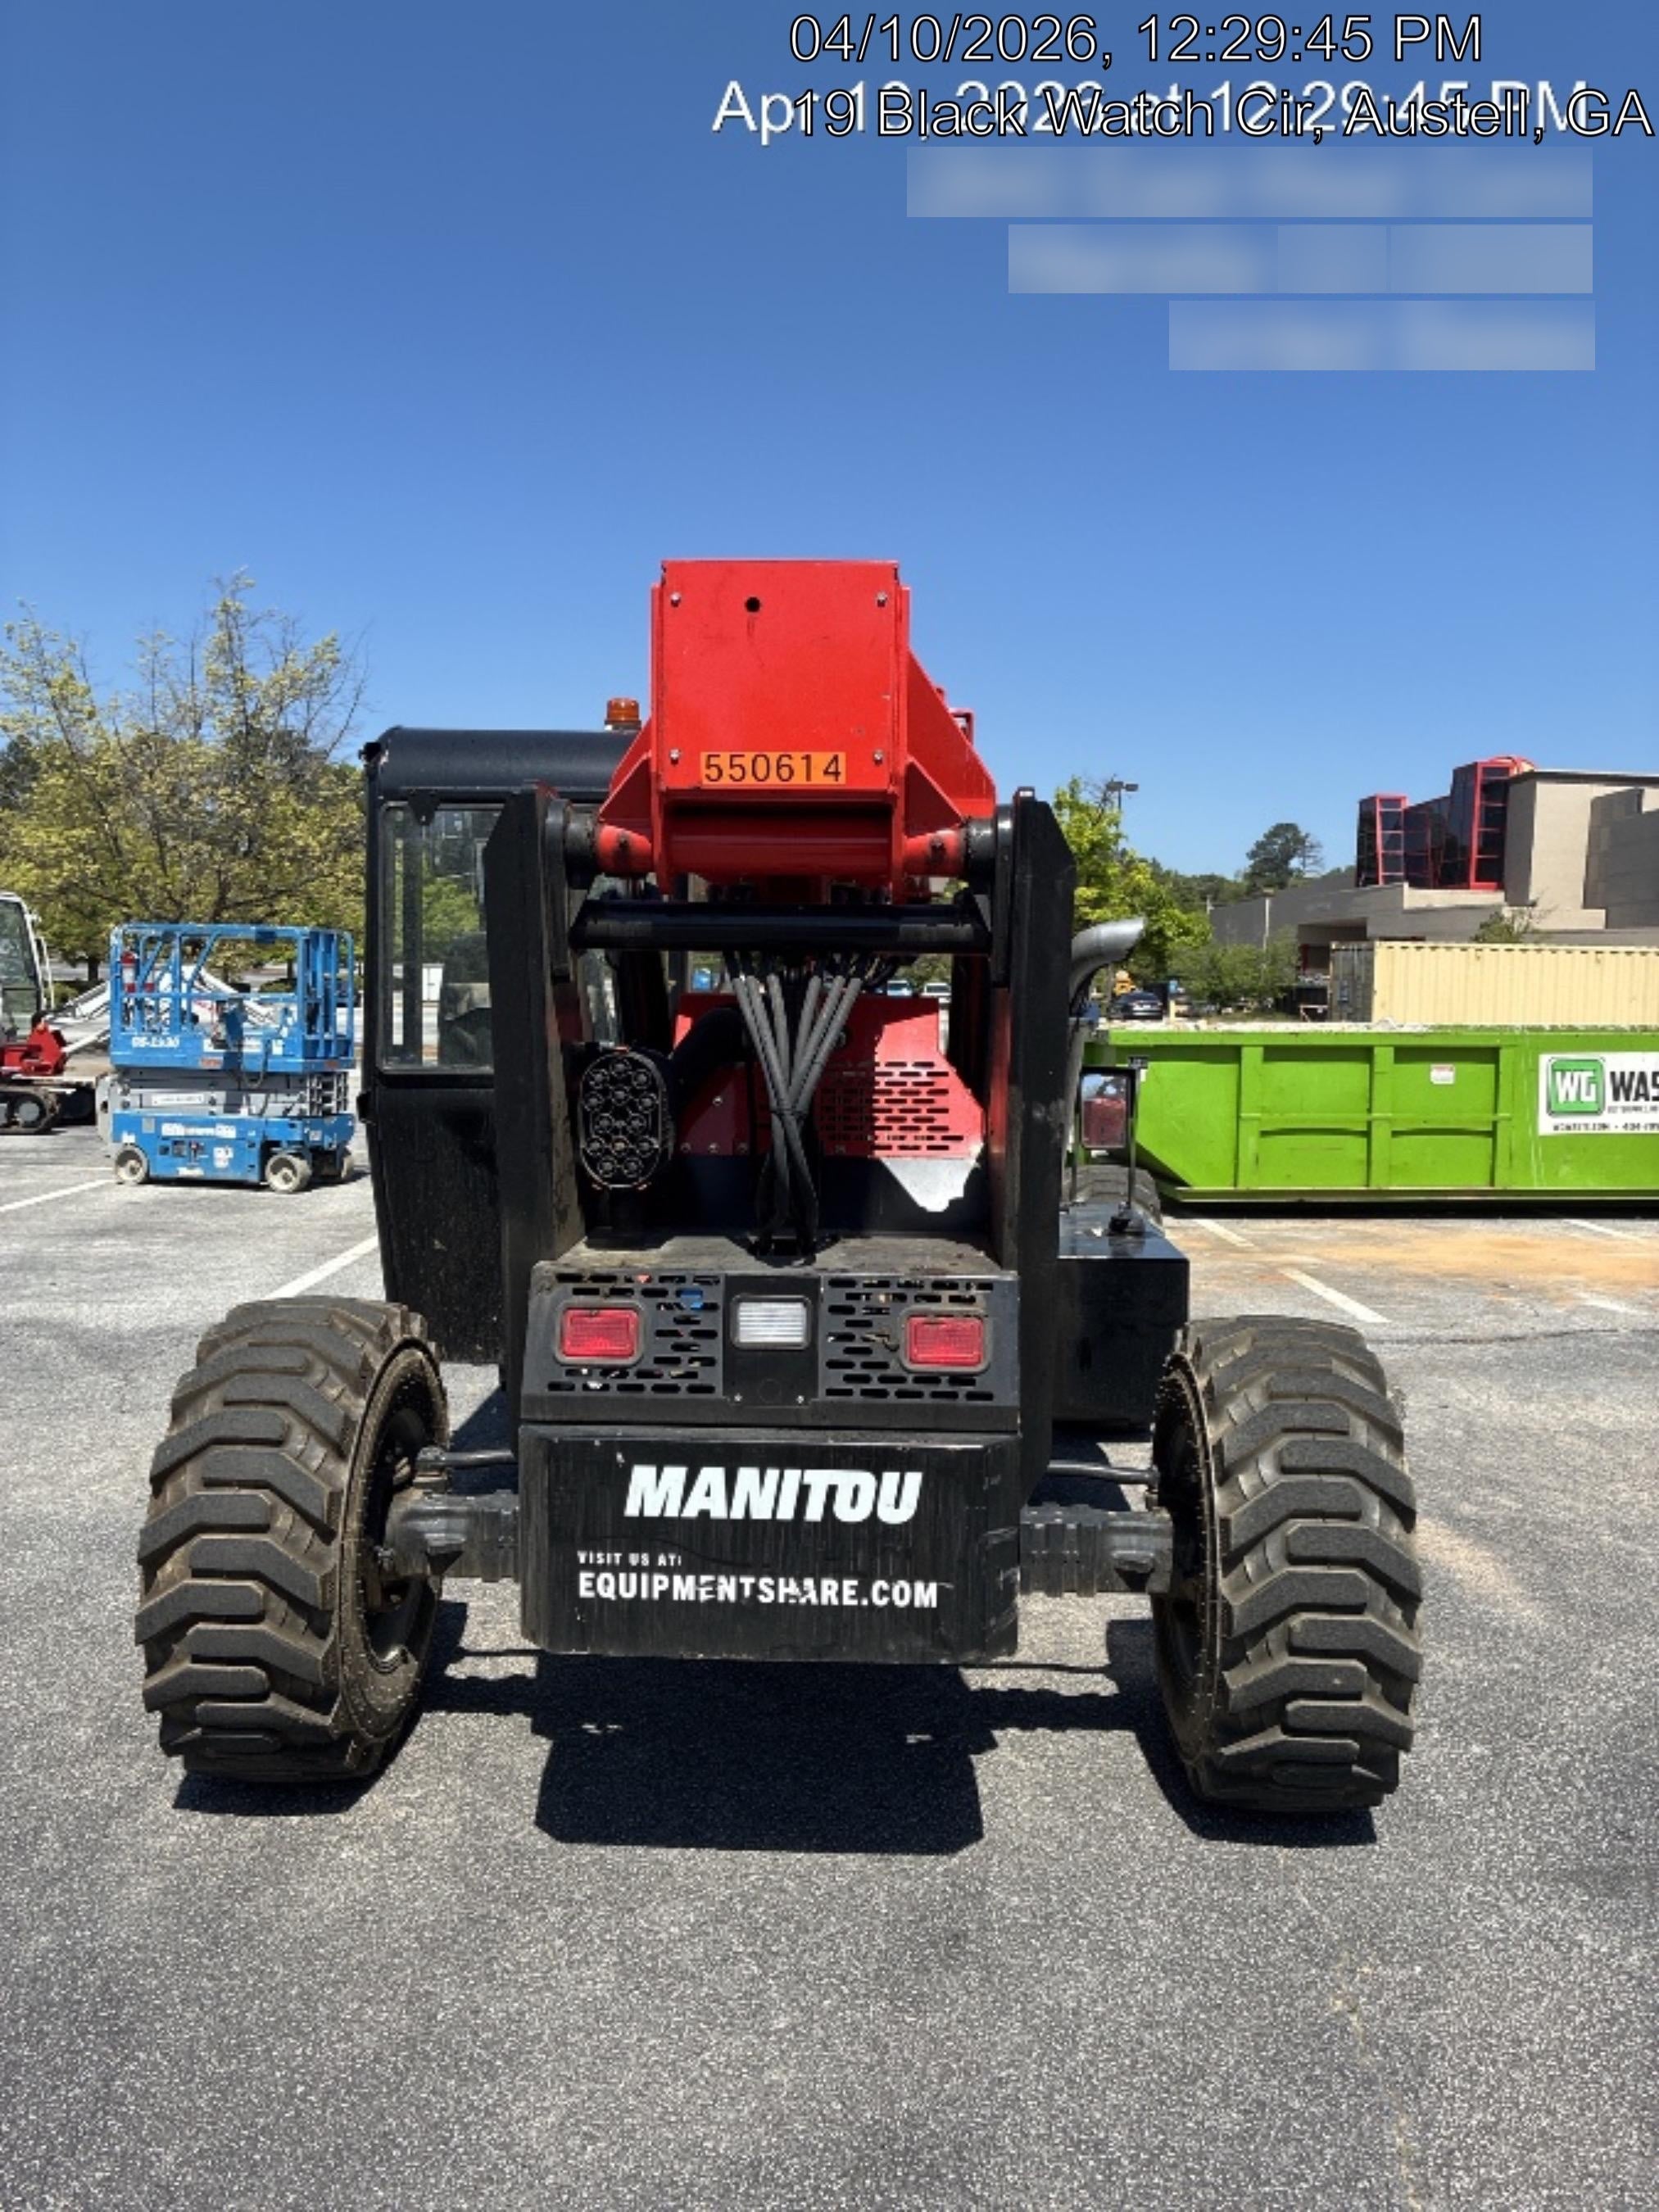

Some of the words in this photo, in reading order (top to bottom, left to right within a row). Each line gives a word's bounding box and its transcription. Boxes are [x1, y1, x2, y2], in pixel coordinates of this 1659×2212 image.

[704, 754, 842, 782] 550614
[1555, 1070, 1598, 1104] WG
[623, 1464, 923, 1525] MANITOU
[577, 1550, 623, 1566] VISIT
[628, 1552, 650, 1567] US
[578, 1570, 939, 1609] EQUIPMENTSHARE.COM
